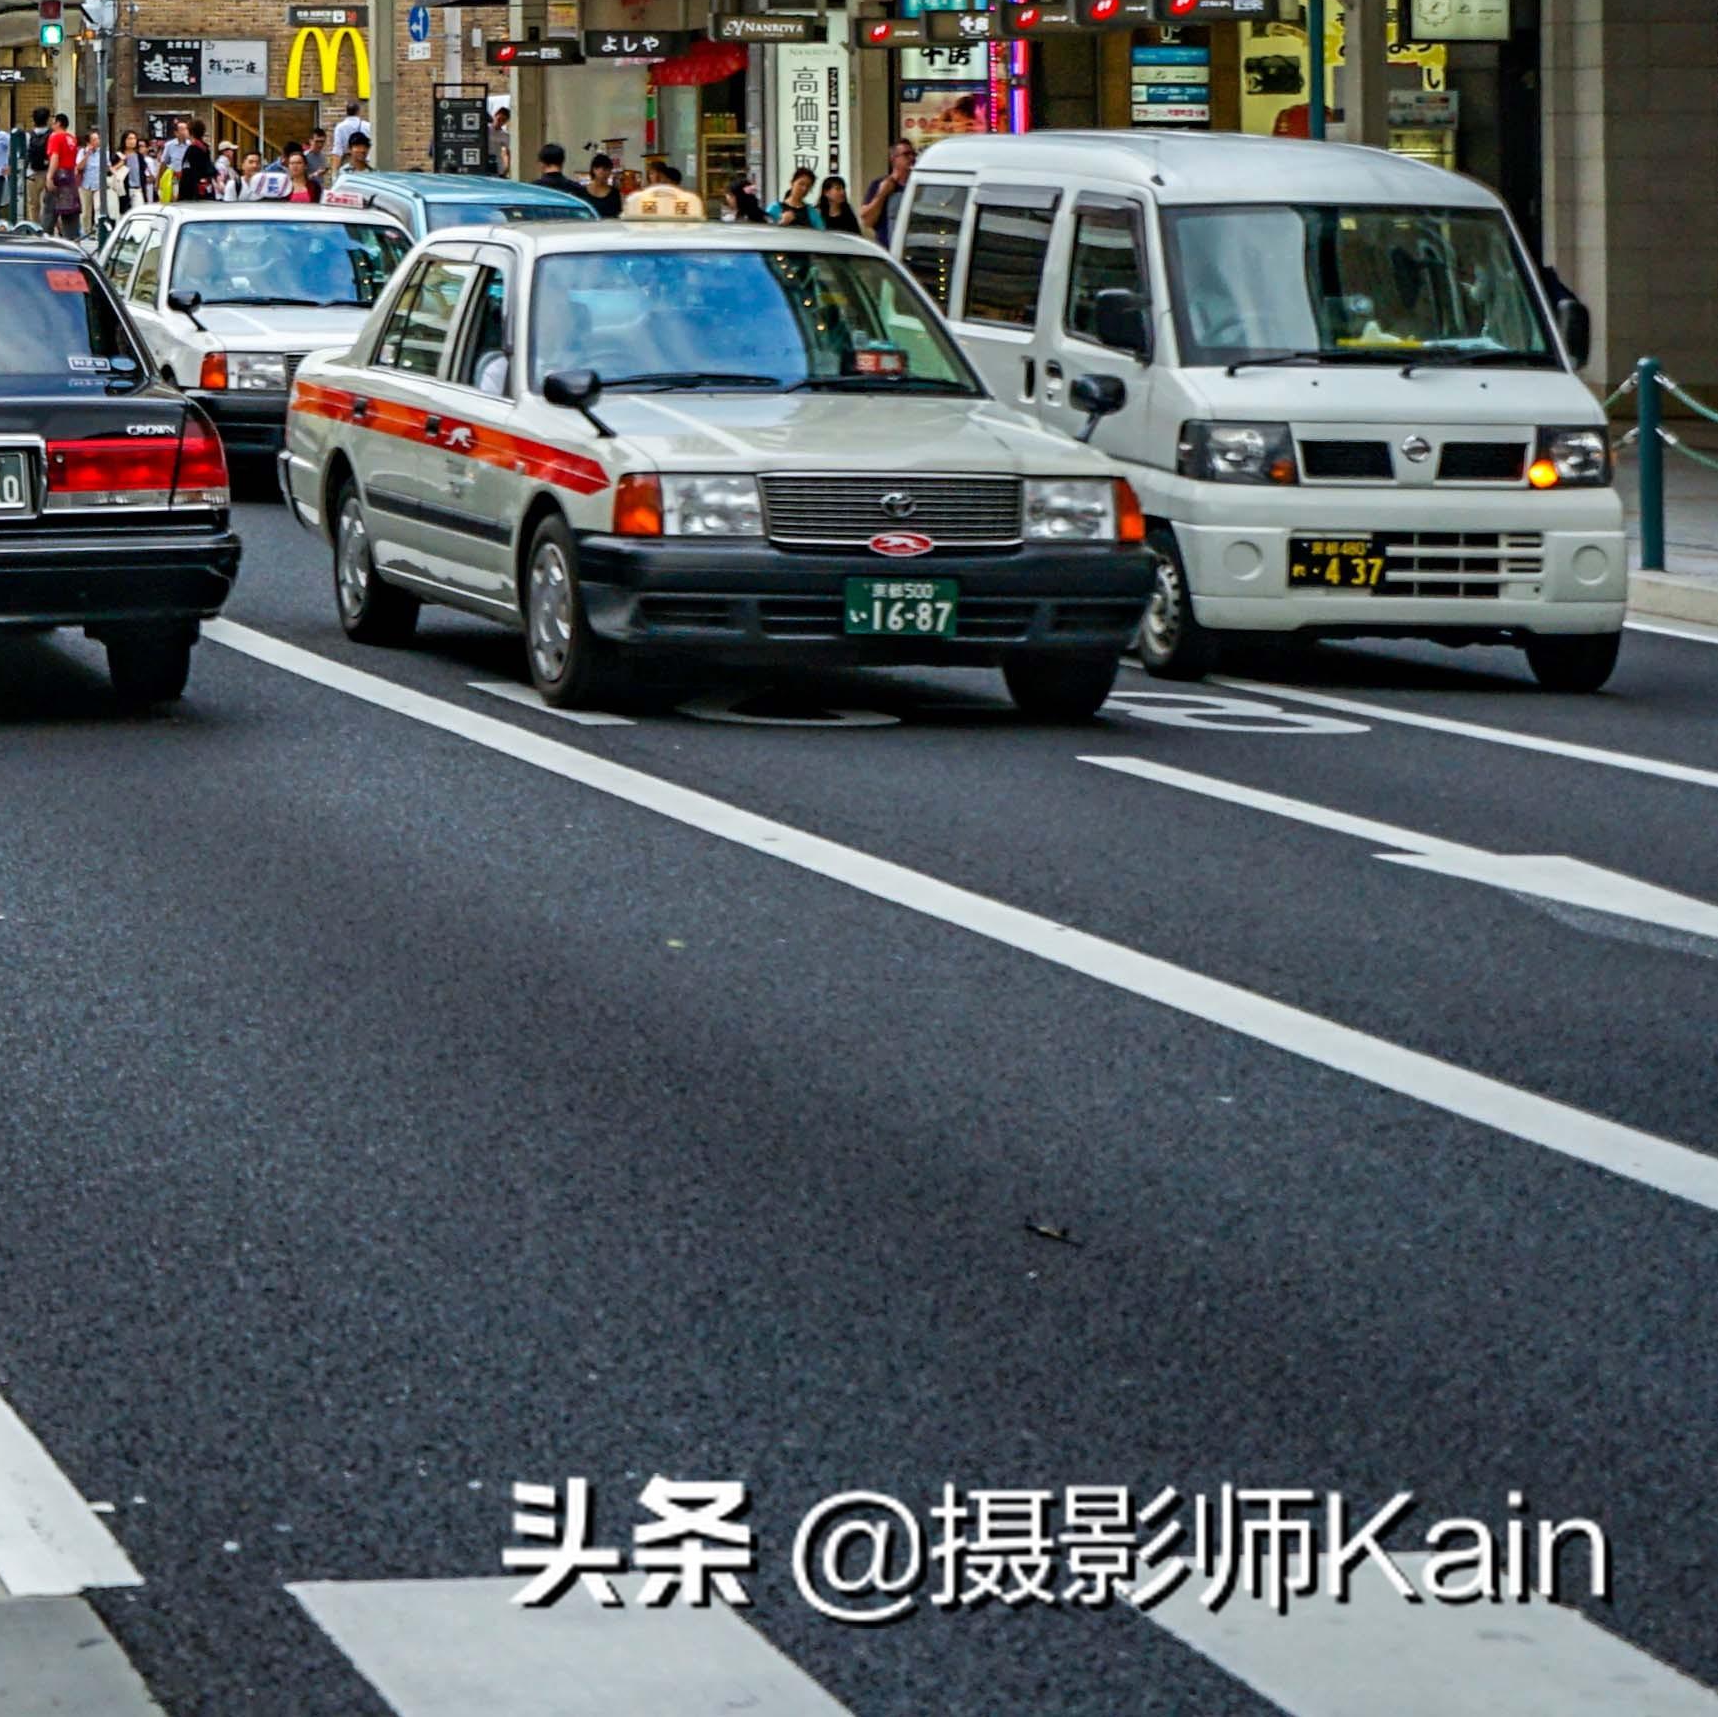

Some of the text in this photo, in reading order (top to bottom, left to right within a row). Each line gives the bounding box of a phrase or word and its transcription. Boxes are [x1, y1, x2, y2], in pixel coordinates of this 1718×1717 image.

[601, 36, 660, 53] よしや
[126, 424, 176, 435] CROWN
[873, 600, 953, 633] 16-87
